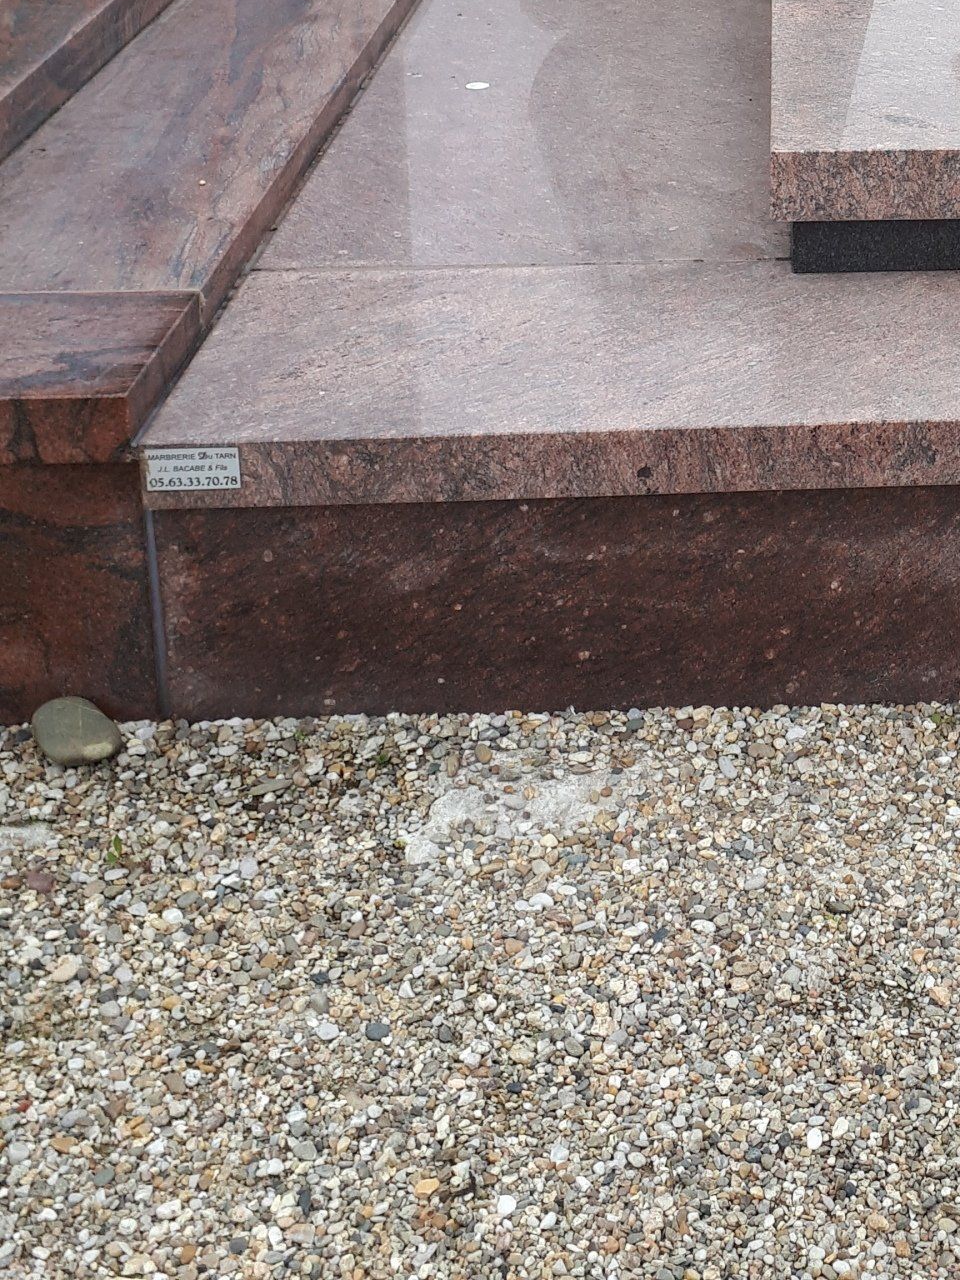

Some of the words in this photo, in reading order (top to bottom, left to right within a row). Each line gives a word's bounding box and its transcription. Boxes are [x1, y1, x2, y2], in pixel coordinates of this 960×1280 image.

[147, 453, 196, 461] MARBRERIE
[215, 452, 237, 460] TARN
[207, 464, 213, 472] &
[149, 476, 238, 488] 05.63.33.70.78
